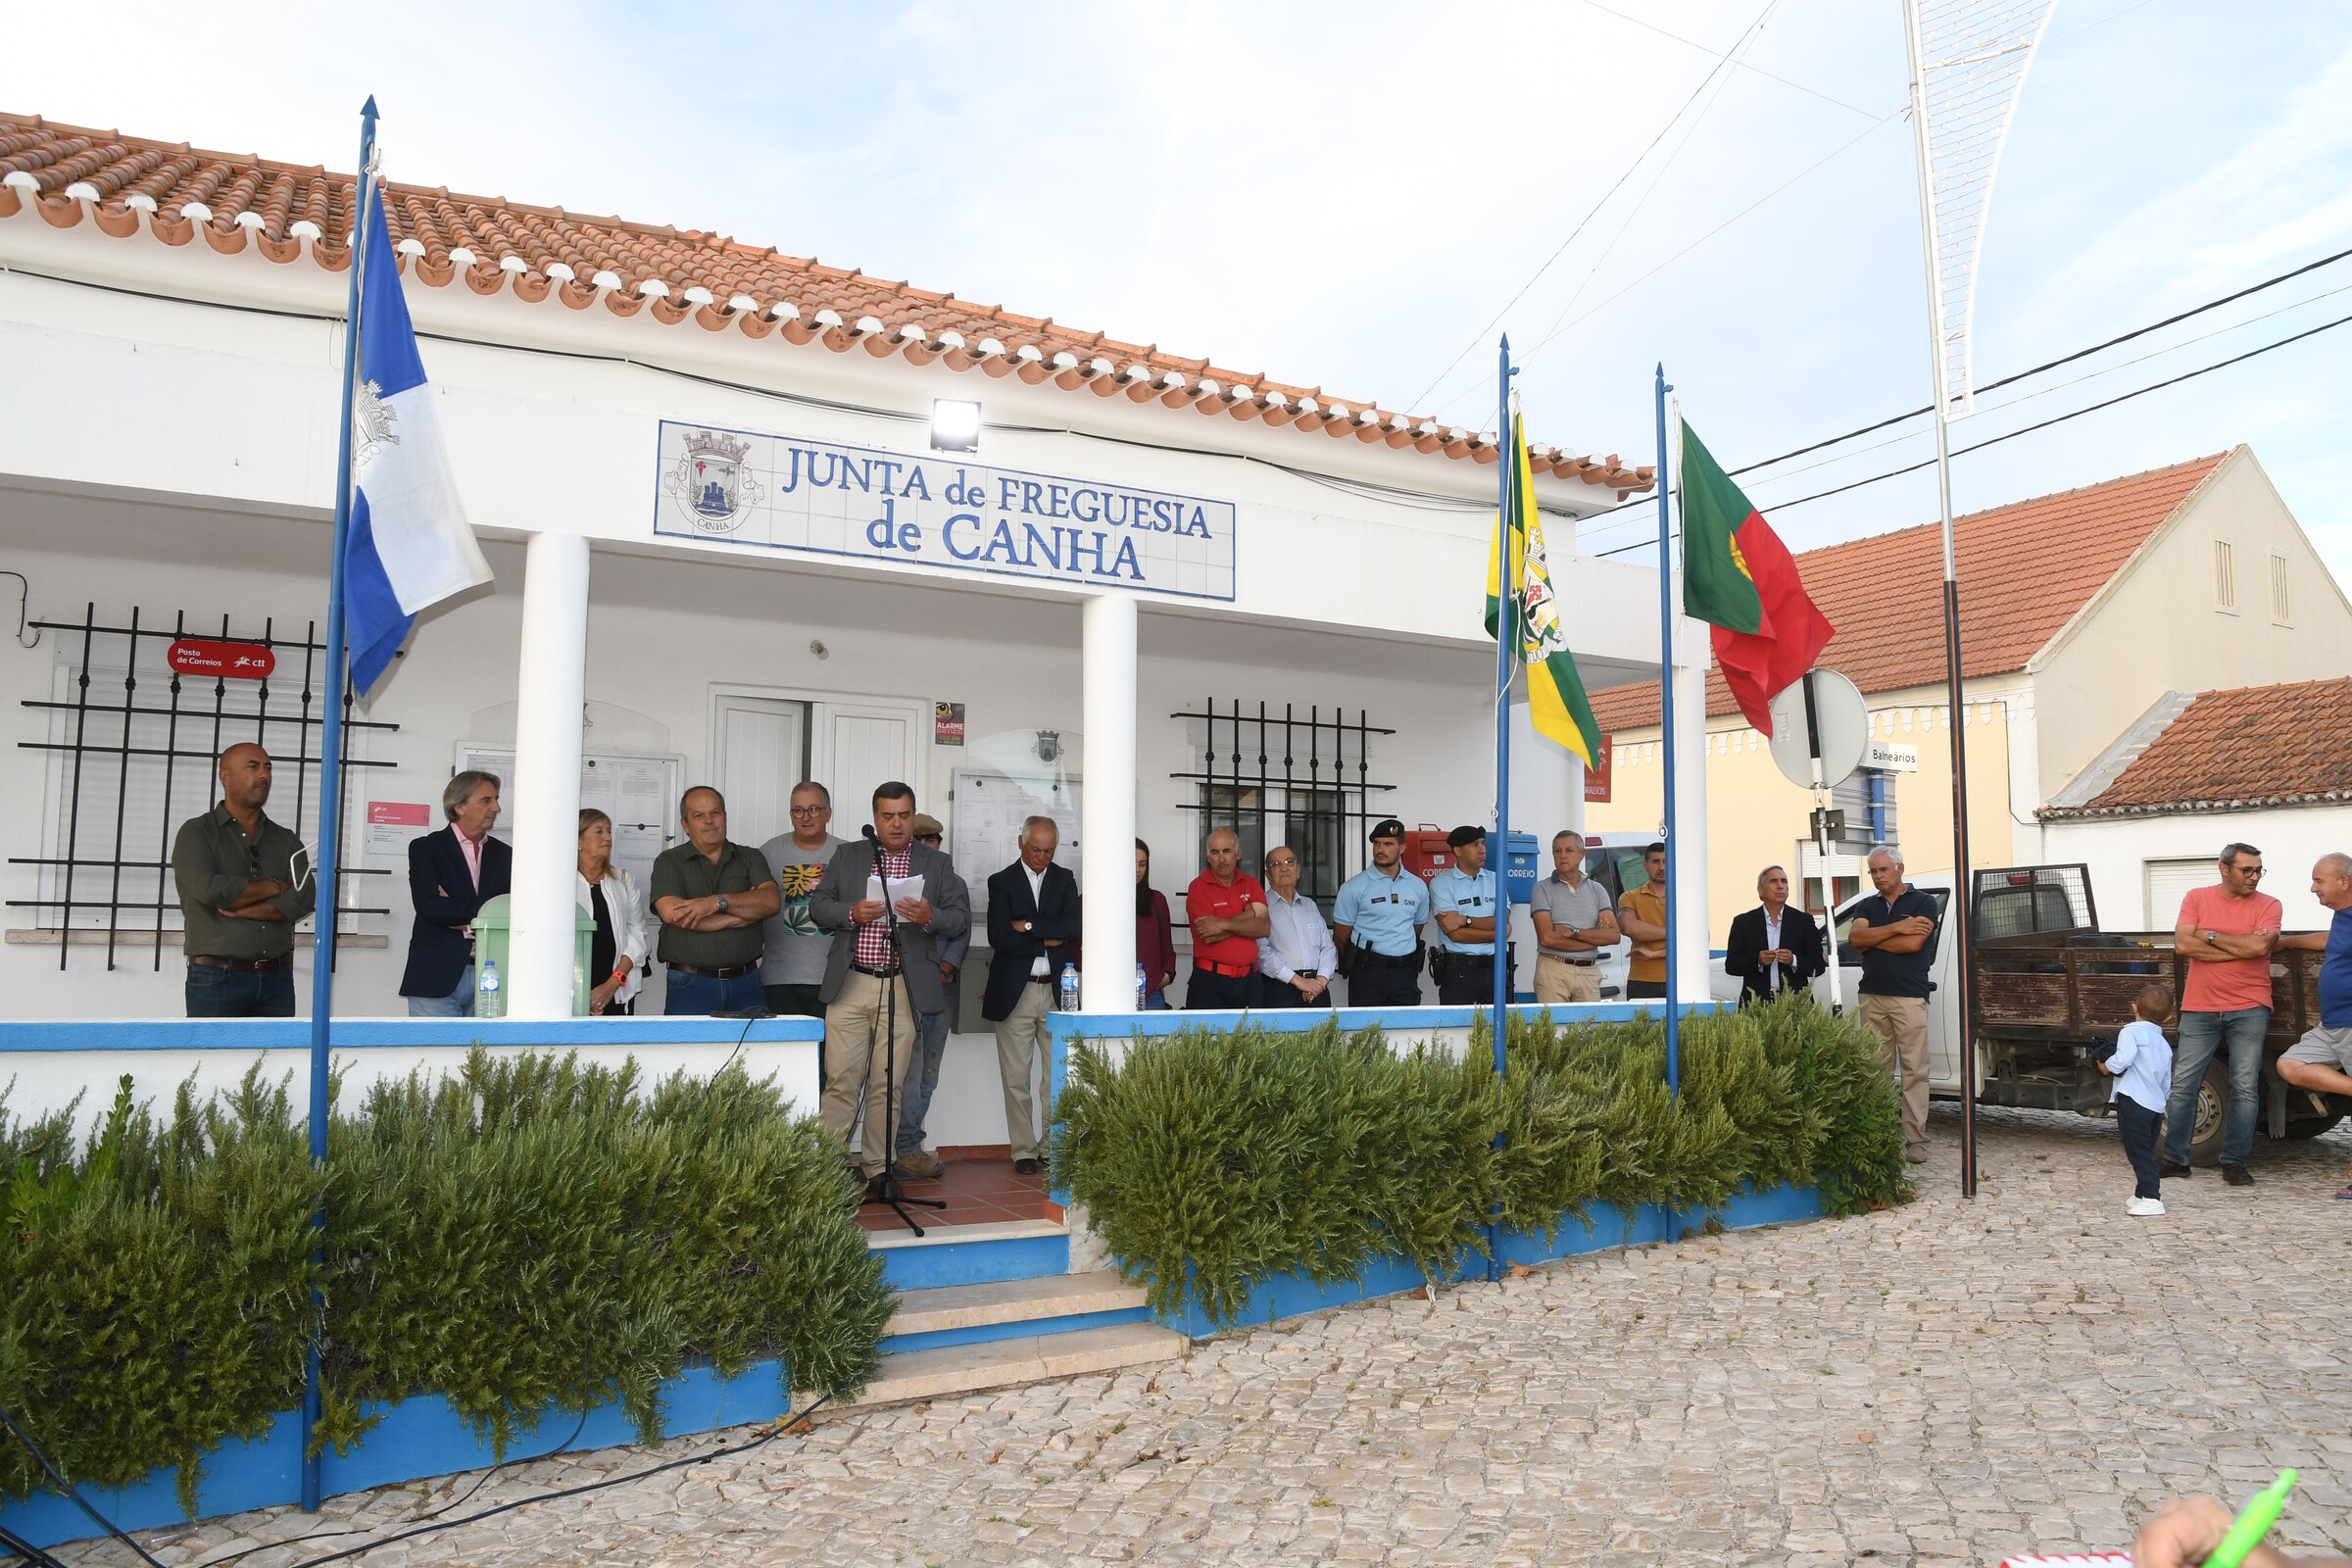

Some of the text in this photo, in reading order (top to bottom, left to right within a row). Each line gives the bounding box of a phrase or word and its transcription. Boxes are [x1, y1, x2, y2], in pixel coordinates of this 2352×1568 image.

[782, 447, 1213, 540] JUNTA de FREGUESIA
[697, 517, 730, 530] CANHA
[865, 498, 1146, 581] de CANHA
[177, 648, 266, 667] Posto ctt
[188, 657, 222, 666] Correios
[1873, 749, 1915, 762] Balneários
[1507, 869, 1536, 878] ORREIO
